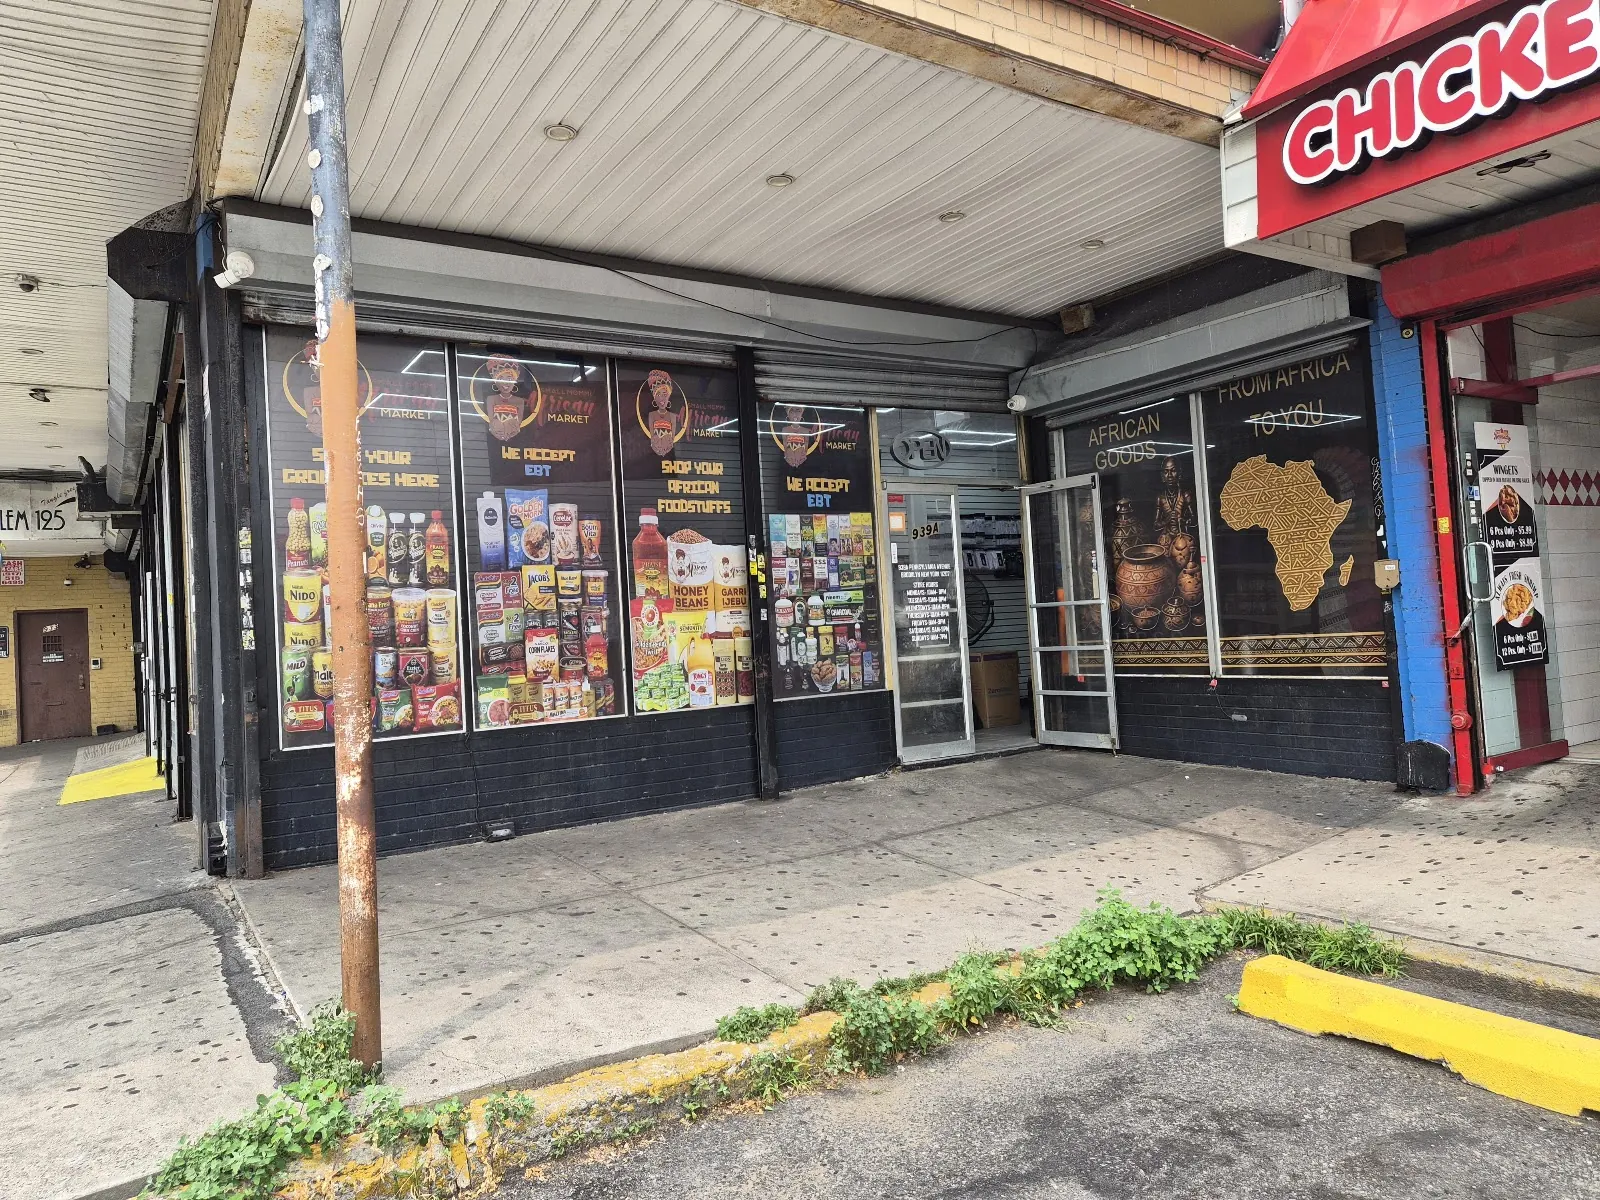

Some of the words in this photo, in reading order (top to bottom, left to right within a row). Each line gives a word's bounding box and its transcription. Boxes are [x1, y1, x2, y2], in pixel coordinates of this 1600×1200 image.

[1218, 373, 1271, 403] FROM
[1275, 353, 1351, 390] AFRICA
[380, 408, 433, 420] MARKET
[547, 412, 590, 424] MARKET
[1249, 410, 1276, 437] TO
[1279, 399, 1324, 431] YOU
[693, 428, 724, 438] MARKET
[1088, 412, 1160, 448] AFRICAN
[825, 441, 857, 451] MARKET
[898, 436, 950, 462] OPEN
[365, 449, 412, 465] YOUR
[501, 446, 520, 459] WE
[523, 447, 576, 461] ACCEPT
[1095, 440, 1157, 470] GOODS
[524, 464, 551, 476] EBT
[661, 460, 691, 474] SHOP
[693, 461, 724, 475] YOUR
[394, 472, 440, 488] HERE
[786, 476, 803, 491] WE
[805, 477, 850, 492] ACCEPT
[667, 480, 719, 494] AFRICAN
[657, 499, 732, 513] FOODSTUFFS
[806, 494, 832, 508] EBT
[510, 500, 544, 515] GOLDEN
[35, 510, 66, 530] 125
[523, 510, 544, 520] MORN
[912, 522, 939, 540] 939A
[1490, 526, 1494, 536] 6
[1494, 526, 1504, 536] Pcs
[1503, 525, 1515, 537] Only
[1495, 539, 1505, 549] Pcs
[1504, 538, 1516, 550] Only
[511, 576, 517, 586] 2
[289, 589, 316, 601] NIDO
[674, 586, 709, 597] HONEY
[721, 588, 747, 596] GARRI
[675, 597, 709, 608] BEANS
[722, 597, 747, 606] IJEBU
[512, 613, 519, 623] 2
[1501, 647, 1508, 657] 12
[1516, 645, 1526, 655] Only
[285, 660, 306, 671] MILO
[518, 703, 538, 712] TITUS
